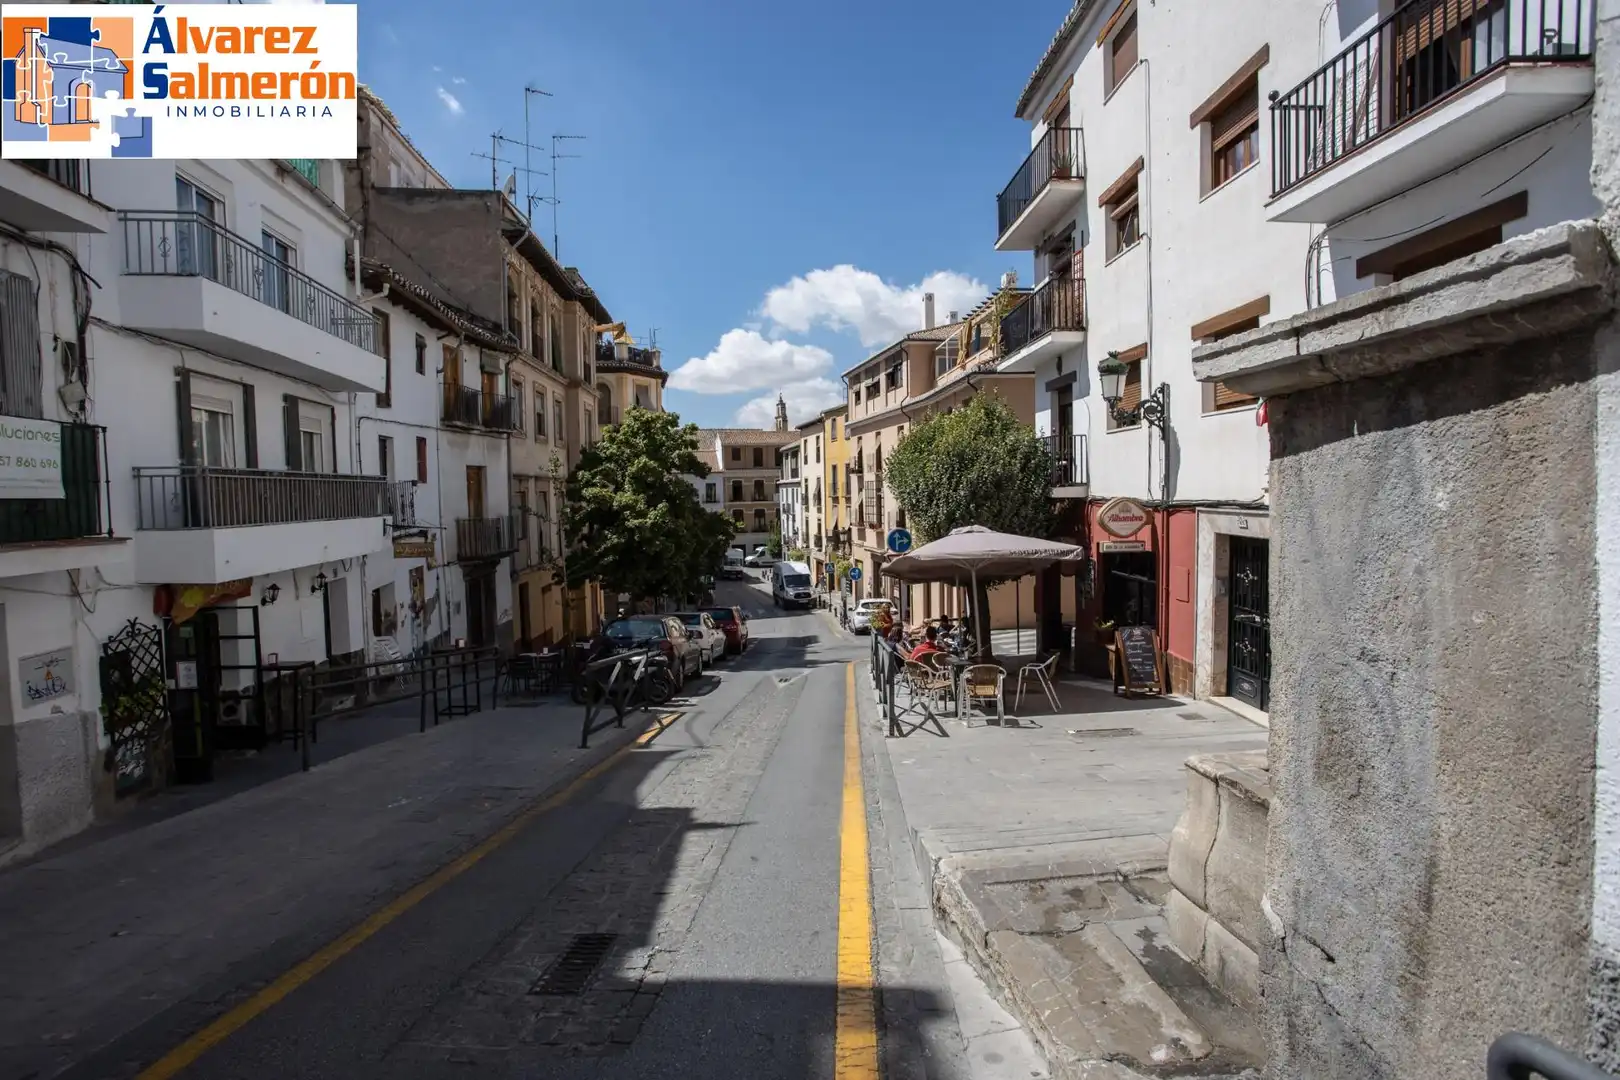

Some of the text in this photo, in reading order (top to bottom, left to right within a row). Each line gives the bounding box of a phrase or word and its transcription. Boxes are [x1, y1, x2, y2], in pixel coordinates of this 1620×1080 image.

[16, 456, 37, 468] 860
[40, 458, 59, 469] 696
[1108, 513, 1144, 523] Alhambra
